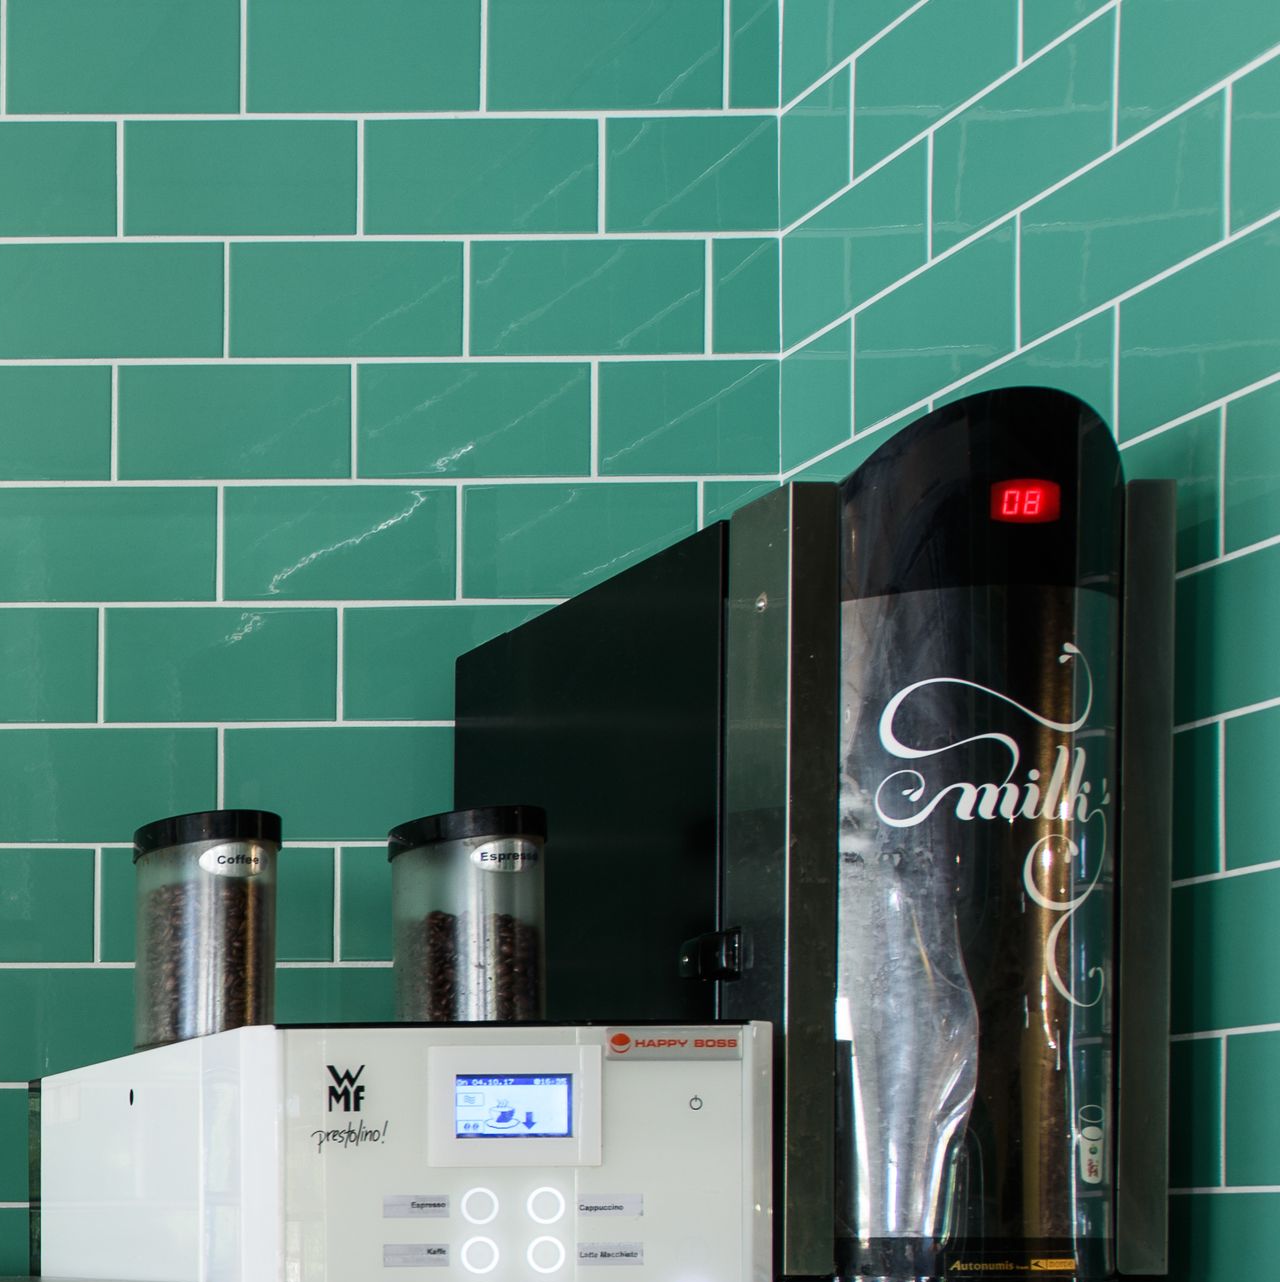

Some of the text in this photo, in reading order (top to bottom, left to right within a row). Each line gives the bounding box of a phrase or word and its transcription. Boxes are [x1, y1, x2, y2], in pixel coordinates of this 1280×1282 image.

[1002, 490, 1041, 515] 08
[217, 854, 259, 865] Coffee
[635, 1039, 737, 1047] HAPPY BOSS
[326, 1065, 366, 1112] WMF
[311, 1120, 388, 1153] prestolino!
[411, 1201, 446, 1209] Espresso
[949, 1260, 1014, 1271] Autonumis
